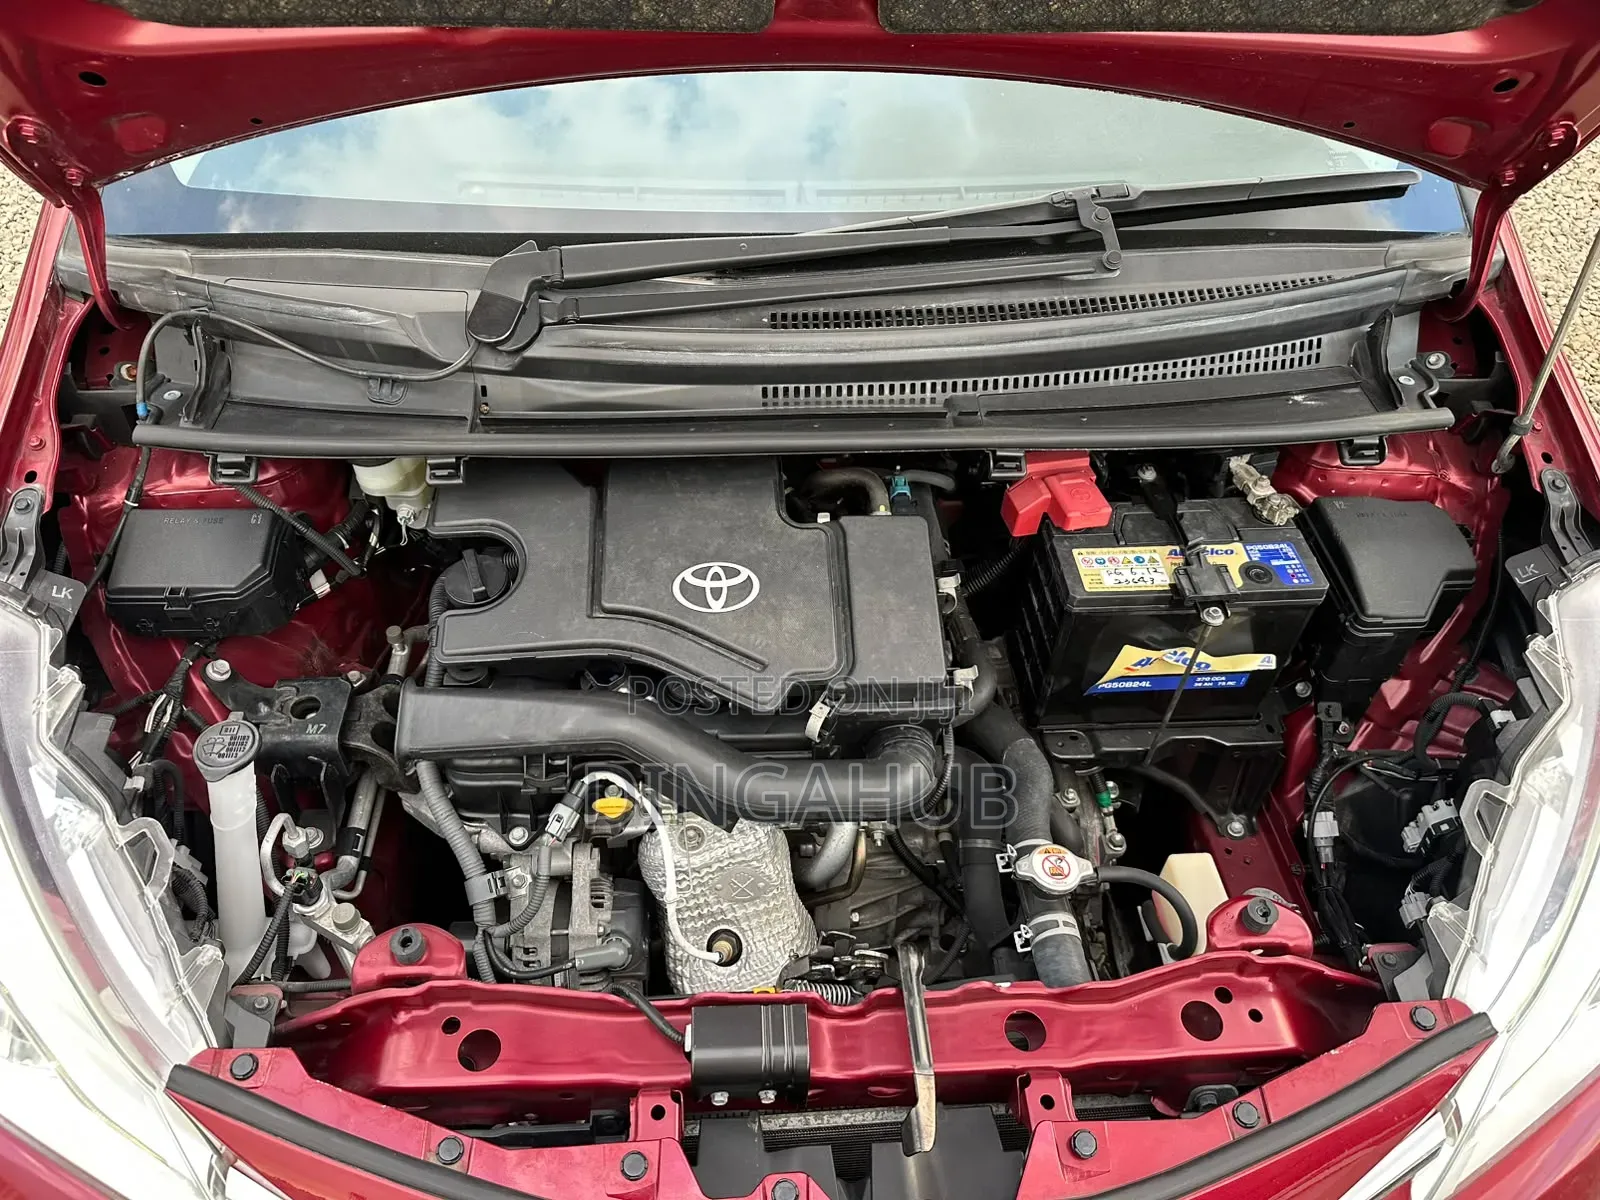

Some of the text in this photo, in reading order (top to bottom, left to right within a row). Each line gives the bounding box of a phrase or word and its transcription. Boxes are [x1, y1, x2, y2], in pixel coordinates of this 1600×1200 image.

[1516, 563, 1539, 578] LK
[51, 585, 74, 600] LK
[1098, 681, 1153, 690] PG50B24L
[306, 723, 327, 735] M7
